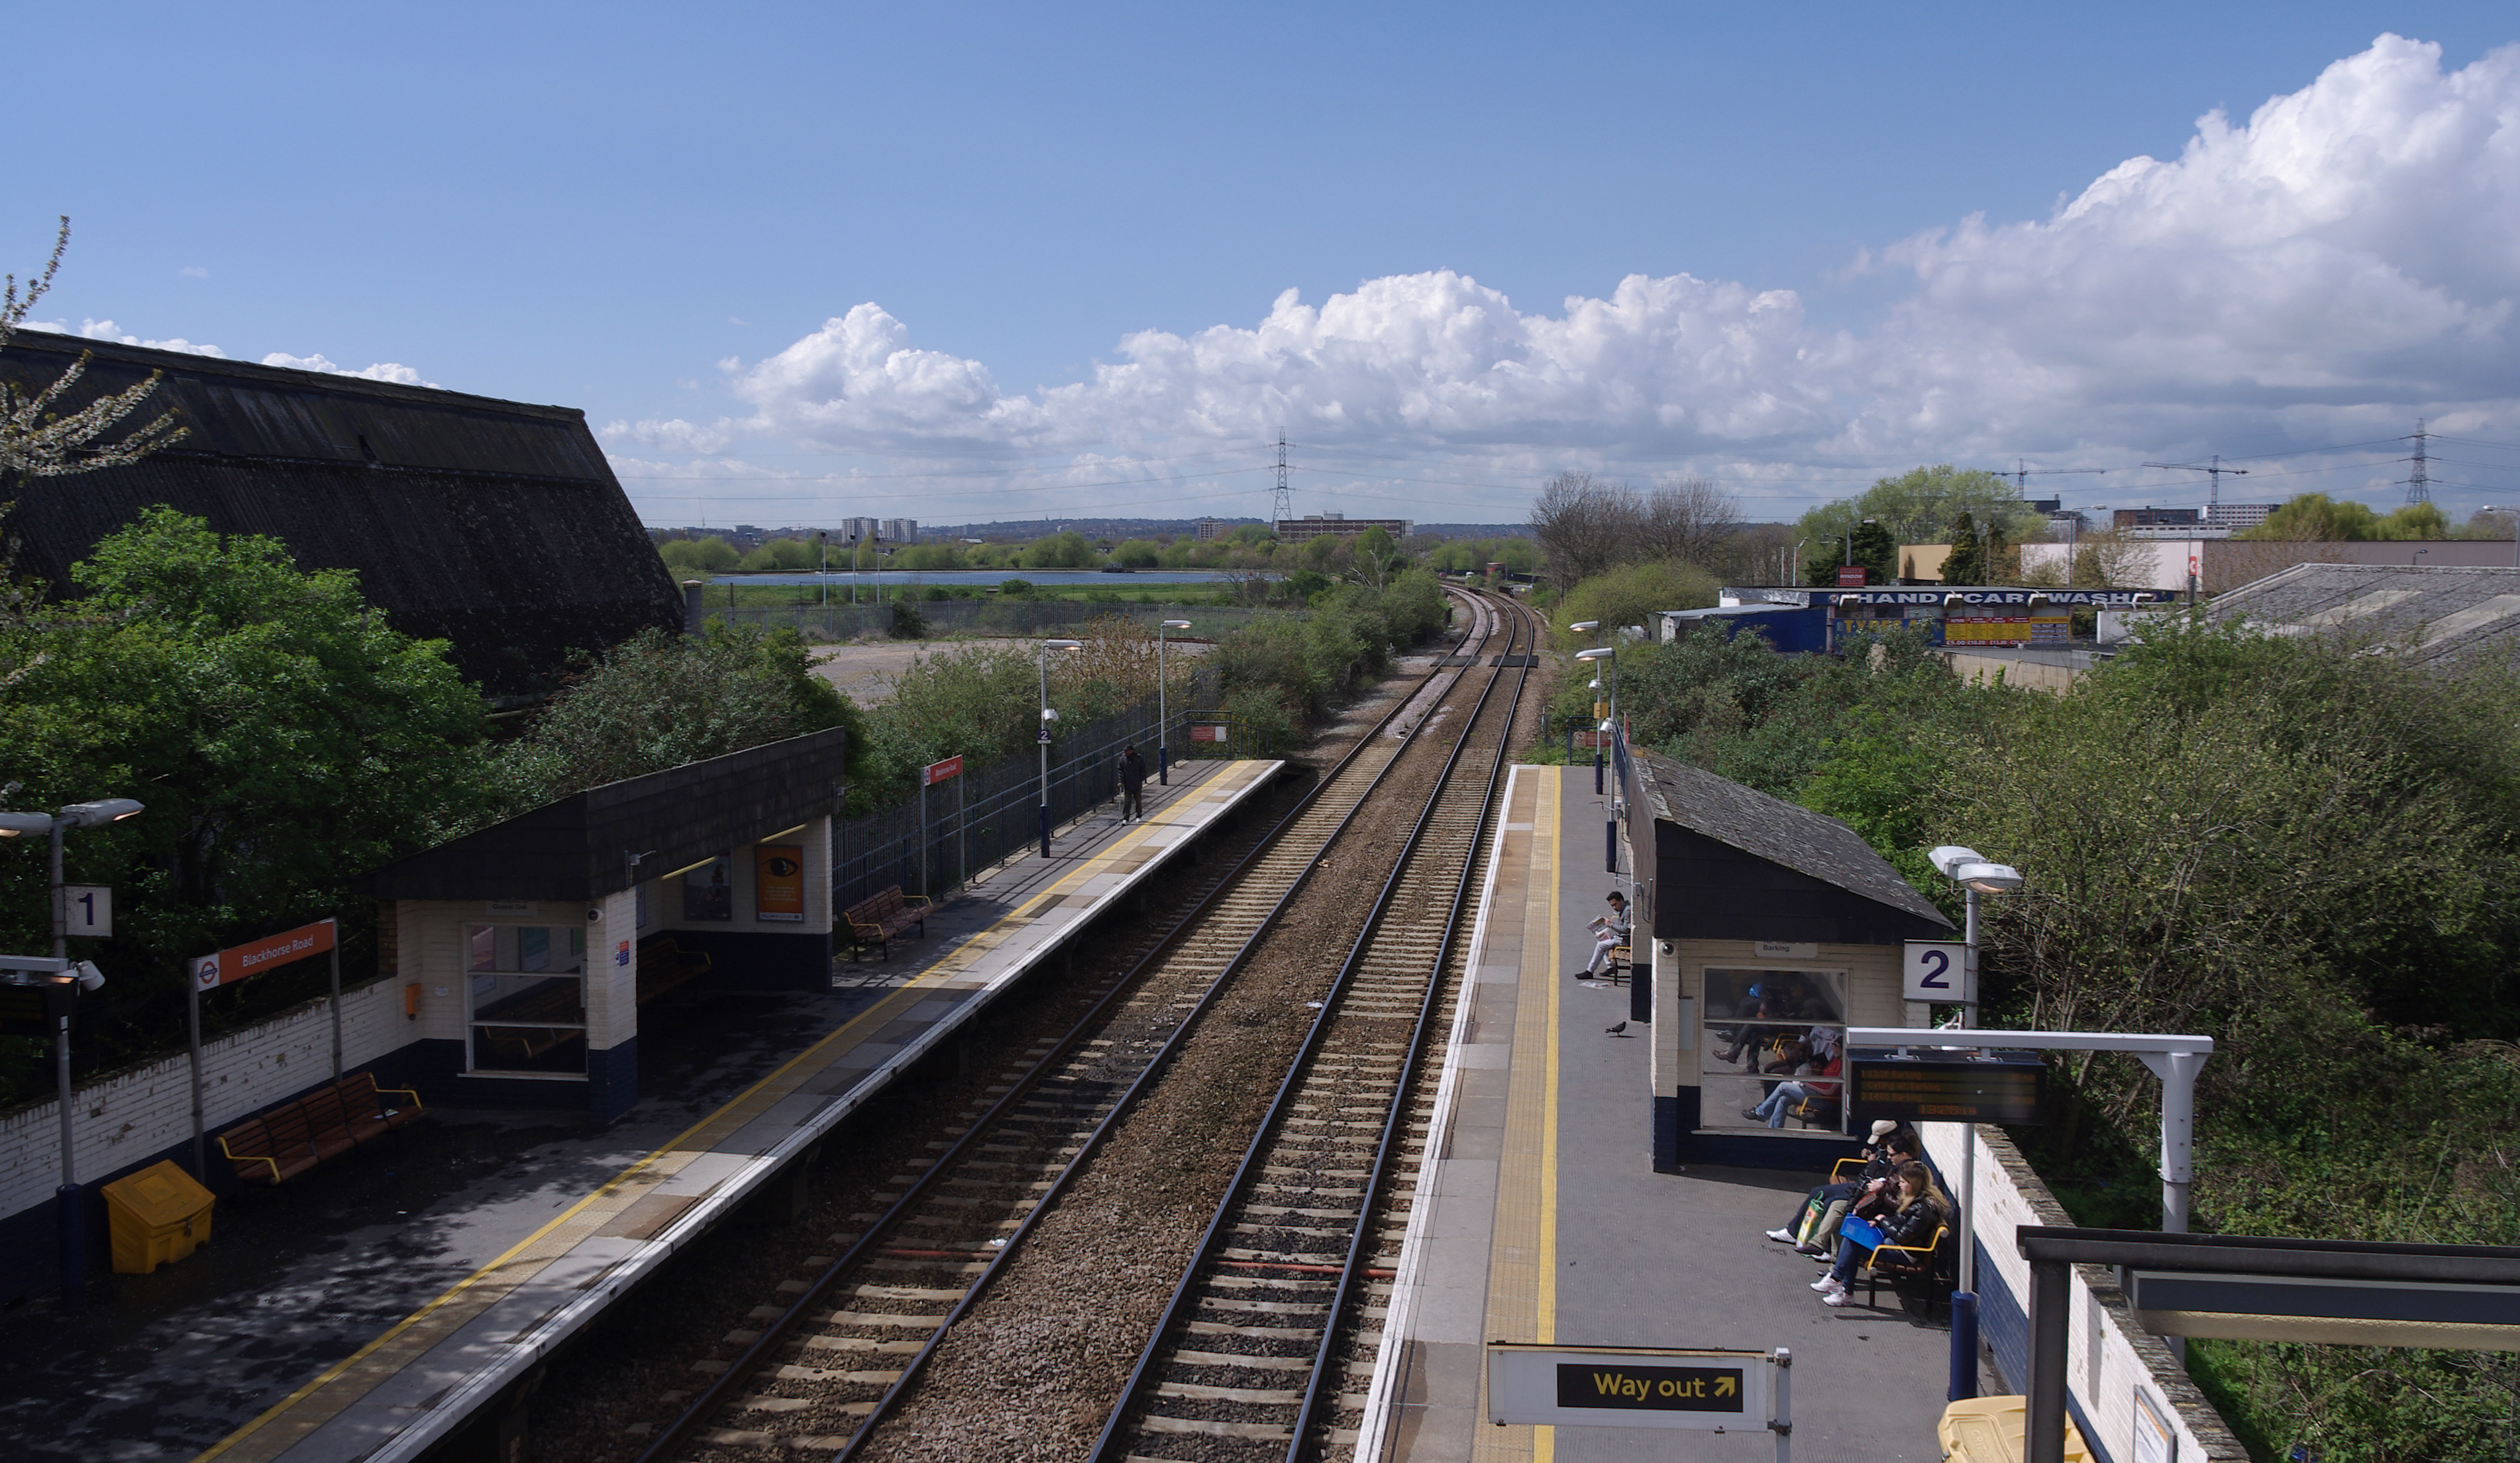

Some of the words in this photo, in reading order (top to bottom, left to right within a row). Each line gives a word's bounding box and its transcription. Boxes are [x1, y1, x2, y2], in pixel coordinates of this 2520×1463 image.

[1856, 593, 1938, 604] HAND
[1963, 593, 2024, 604] CAR
[2046, 593, 2130, 603] WASH
[79, 893, 93, 925] 1
[242, 945, 290, 967] Blackhorse
[292, 935, 313, 951] Road
[1920, 950, 1949, 989] 2
[1593, 1372, 1652, 1402] Way
[1657, 1377, 1706, 1398] out
